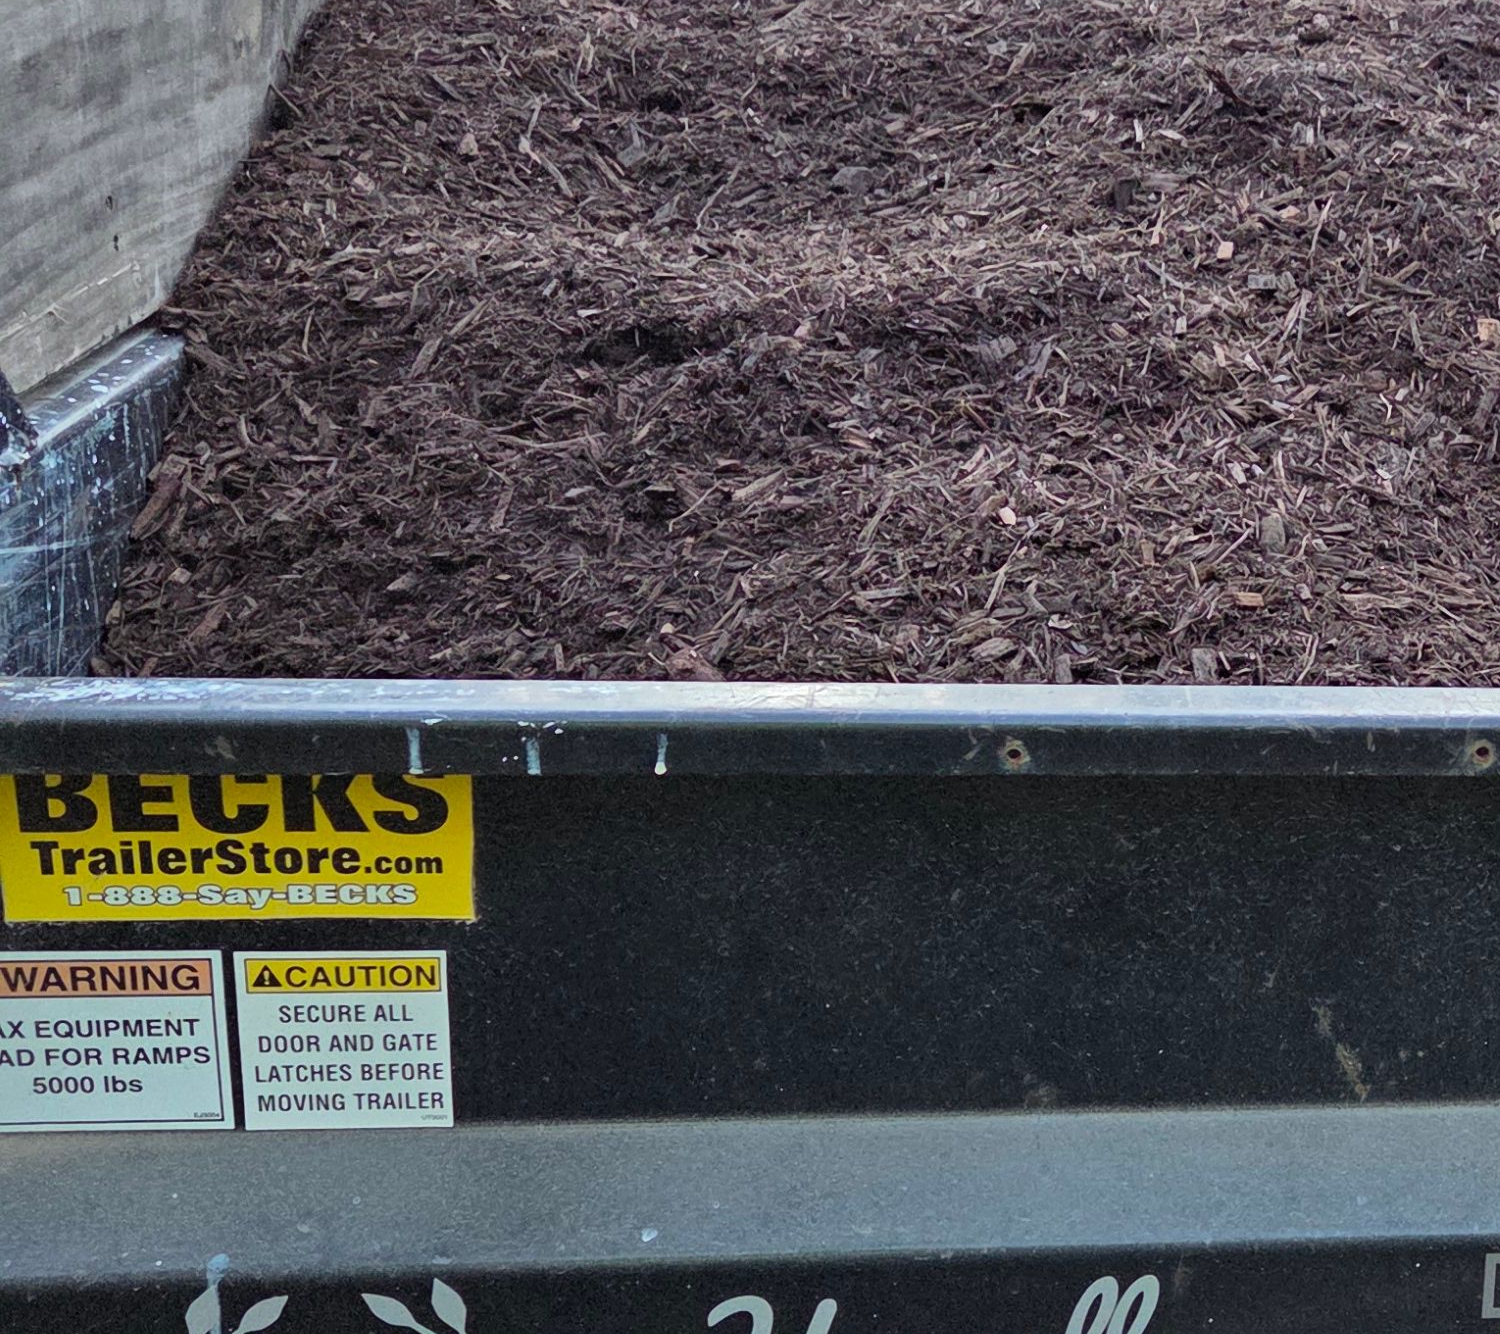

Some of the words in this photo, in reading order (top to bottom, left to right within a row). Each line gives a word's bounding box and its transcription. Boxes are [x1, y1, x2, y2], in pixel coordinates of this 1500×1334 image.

[14, 773, 449, 834] BECKS
[30, 839, 444, 875] TrailerStore.com
[62, 883, 418, 910] 1-888-Say-BECKS
[1, 964, 200, 992] WARNING
[285, 965, 436, 988] CAUTION
[279, 1005, 366, 1023] SECURE
[373, 1004, 414, 1022] ALL
[34, 1018, 200, 1039] EQUIPMENT
[258, 1035, 321, 1053] DOOR
[329, 1034, 375, 1052] AND
[383, 1033, 438, 1051] GATE
[45, 1048, 103, 1066] FOR
[112, 1046, 211, 1065] RAMPS
[255, 1064, 352, 1083] LATCHES
[361, 1063, 445, 1081] BEFORE
[33, 1076, 95, 1094] 5000
[103, 1075, 143, 1094] lbs
[257, 1093, 346, 1112] MOVING
[353, 1091, 445, 1110] TRAILER
